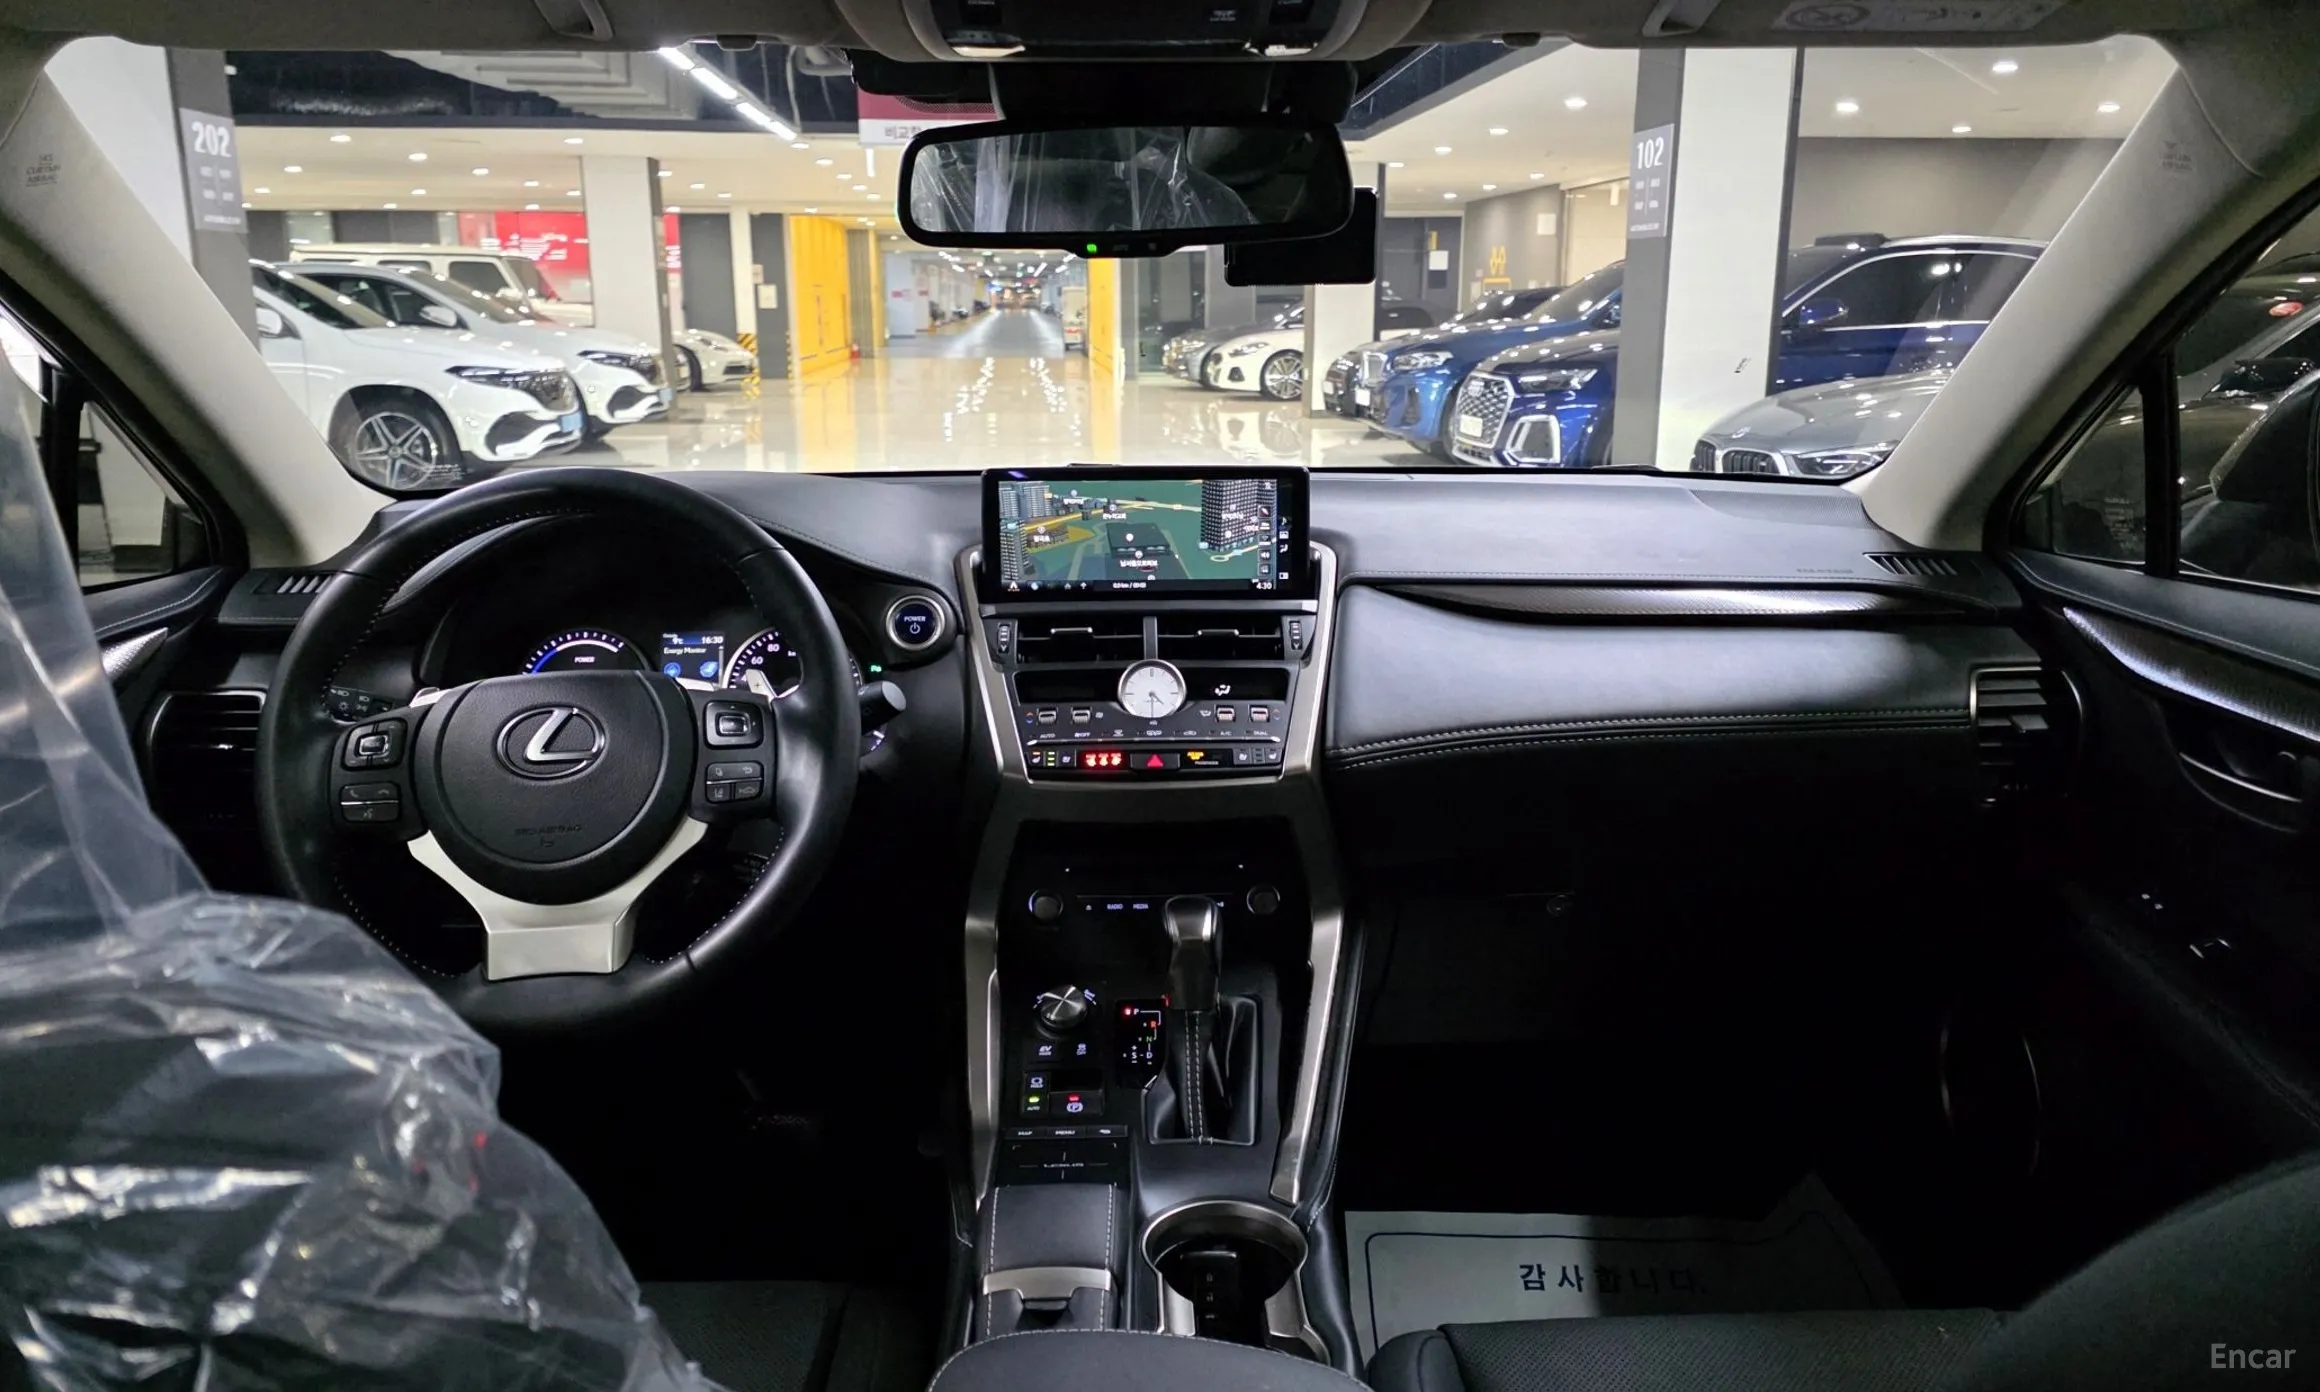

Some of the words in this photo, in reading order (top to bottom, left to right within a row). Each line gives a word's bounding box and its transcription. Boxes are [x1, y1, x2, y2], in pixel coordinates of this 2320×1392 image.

[191, 121, 232, 157] 202
[1636, 136, 1664, 169] 102
[1256, 582, 1272, 590] 4:30
[702, 636, 723, 644] 16:30
[663, 647, 683, 655] Energy
[767, 643, 780, 652] 80
[751, 656, 764, 665] 60
[1131, 1051, 1138, 1059] S
[1146, 1051, 1153, 1059] D
